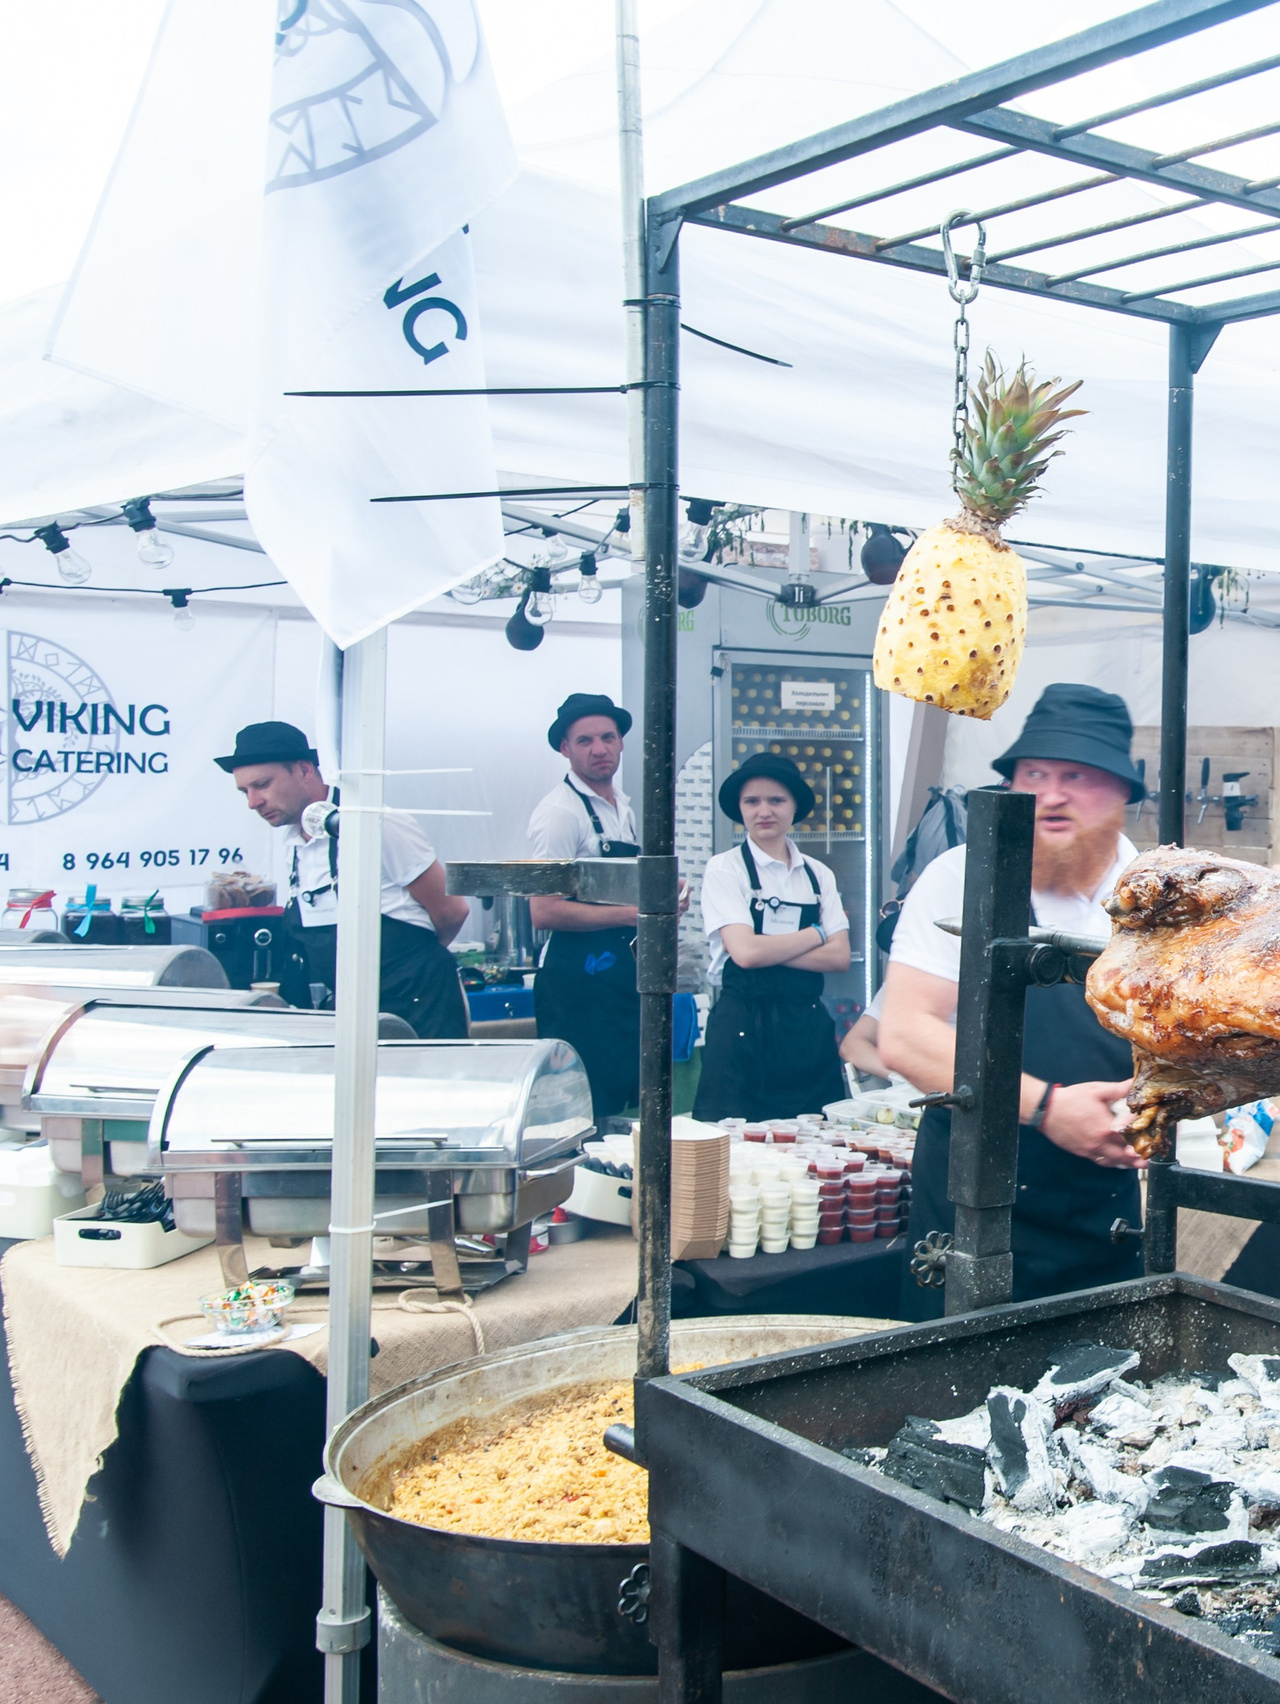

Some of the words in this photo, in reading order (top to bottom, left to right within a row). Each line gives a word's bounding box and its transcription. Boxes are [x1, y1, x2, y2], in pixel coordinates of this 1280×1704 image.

[780, 603, 851, 626] TUBORG
[12, 699, 171, 736] VIKING
[12, 749, 169, 774] CATERING
[62, 853, 76, 870] 8
[86, 852, 130, 870] 964
[139, 849, 180, 867] 905
[189, 849, 210, 865] 17
[218, 847, 244, 864] 96
